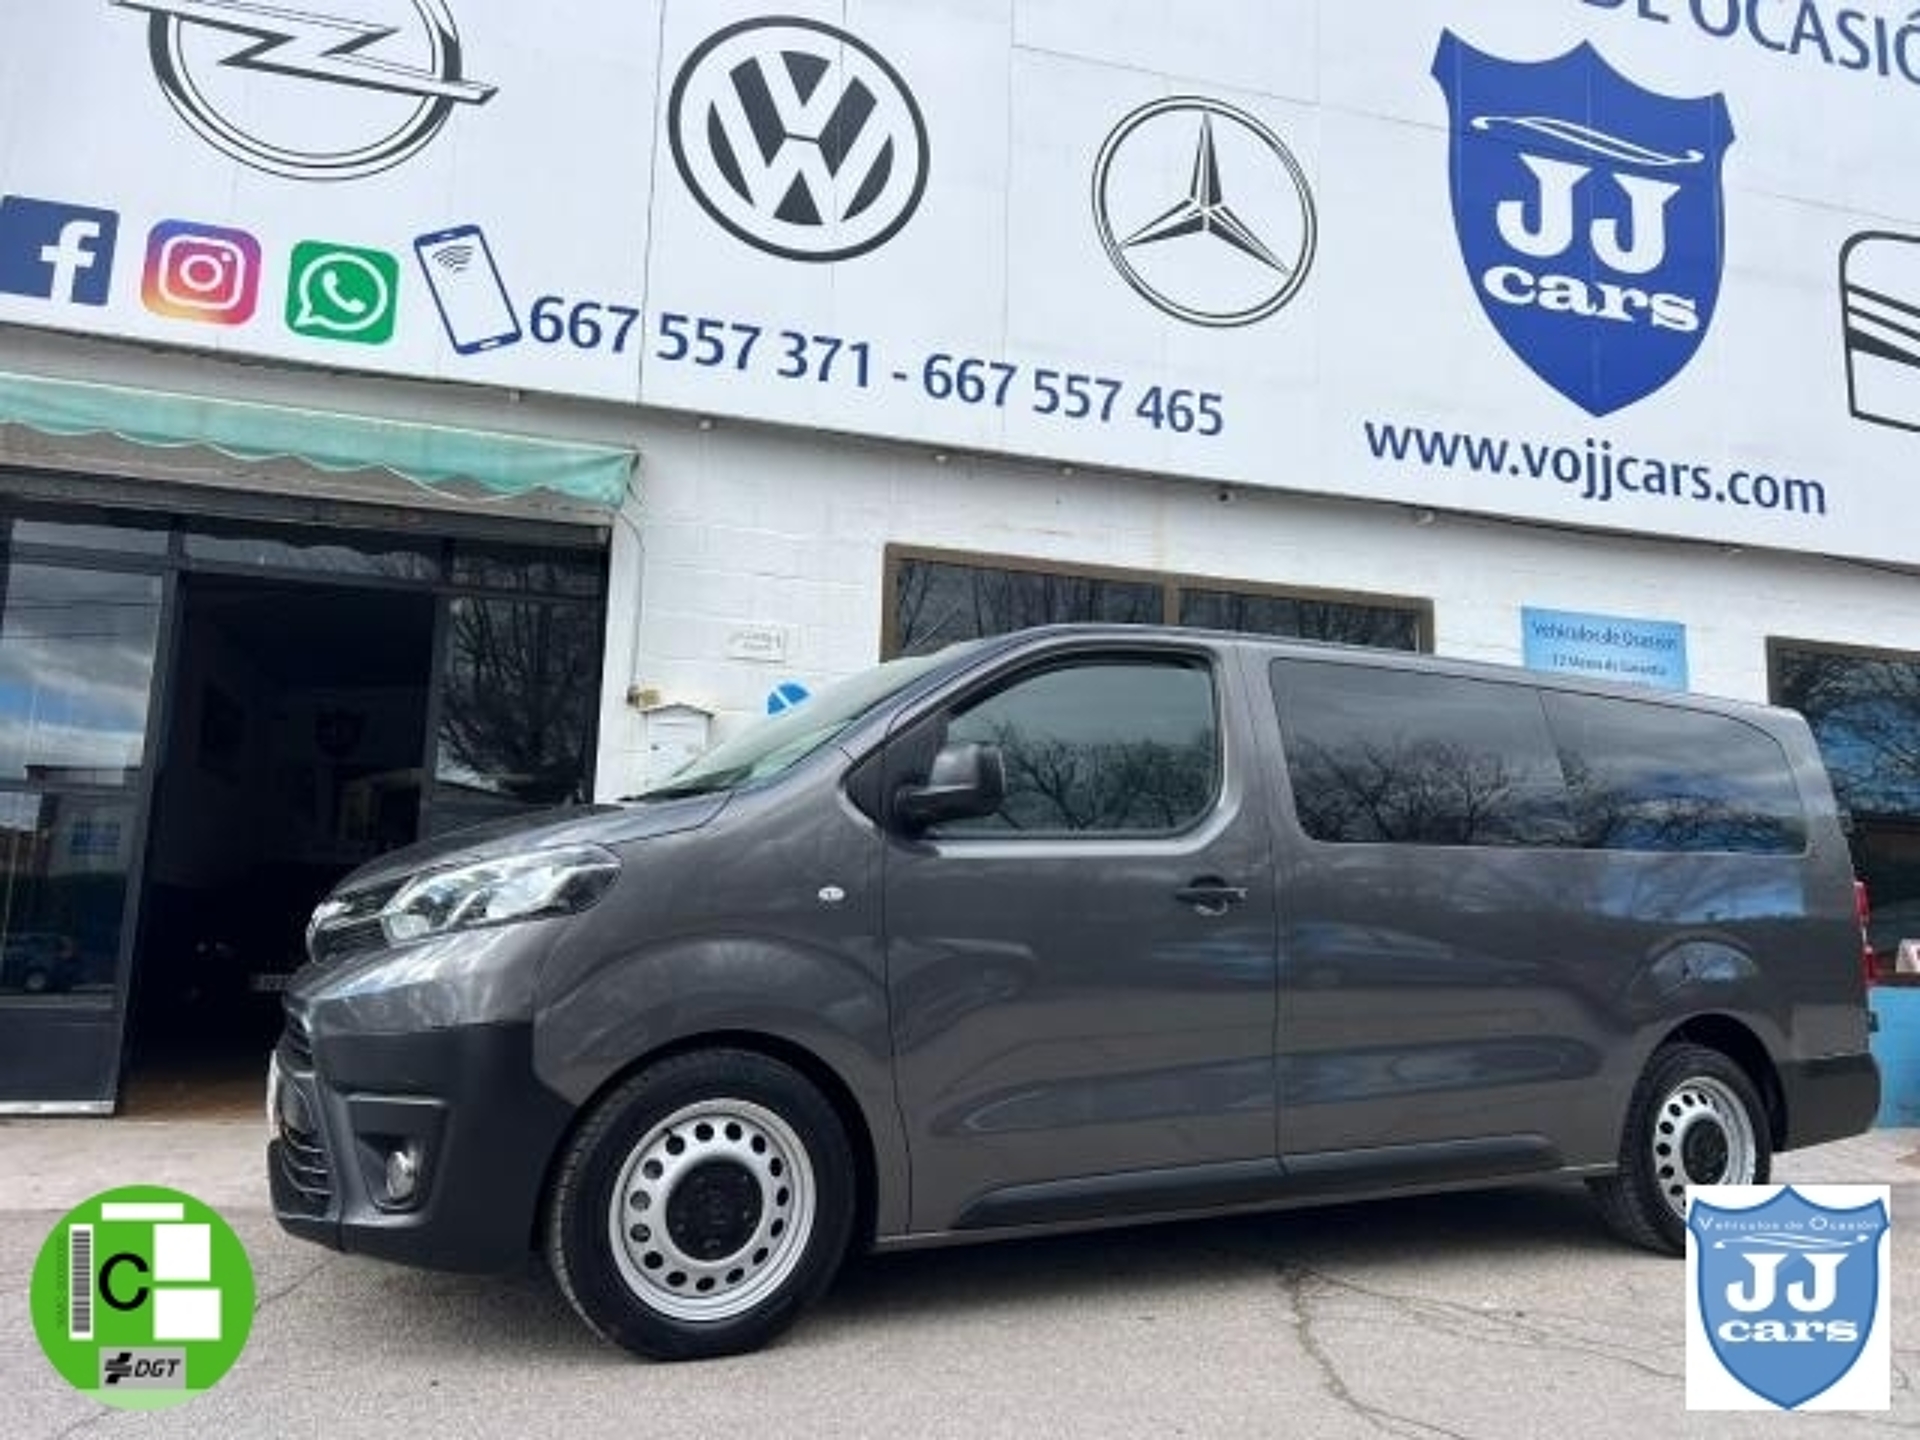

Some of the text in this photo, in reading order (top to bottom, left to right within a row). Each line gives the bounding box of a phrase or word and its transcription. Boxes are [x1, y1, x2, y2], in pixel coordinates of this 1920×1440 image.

[1496, 153, 1681, 274] JJ
[1483, 265, 1699, 333] cars
[529, 295, 640, 353] 667
[656, 312, 763, 371] 557
[777, 330, 871, 388] 371
[923, 353, 1018, 407] 667
[1033, 369, 1122, 422] 557
[1136, 386, 1224, 436] 465
[1364, 420, 1827, 515] www.vojjcars.com
